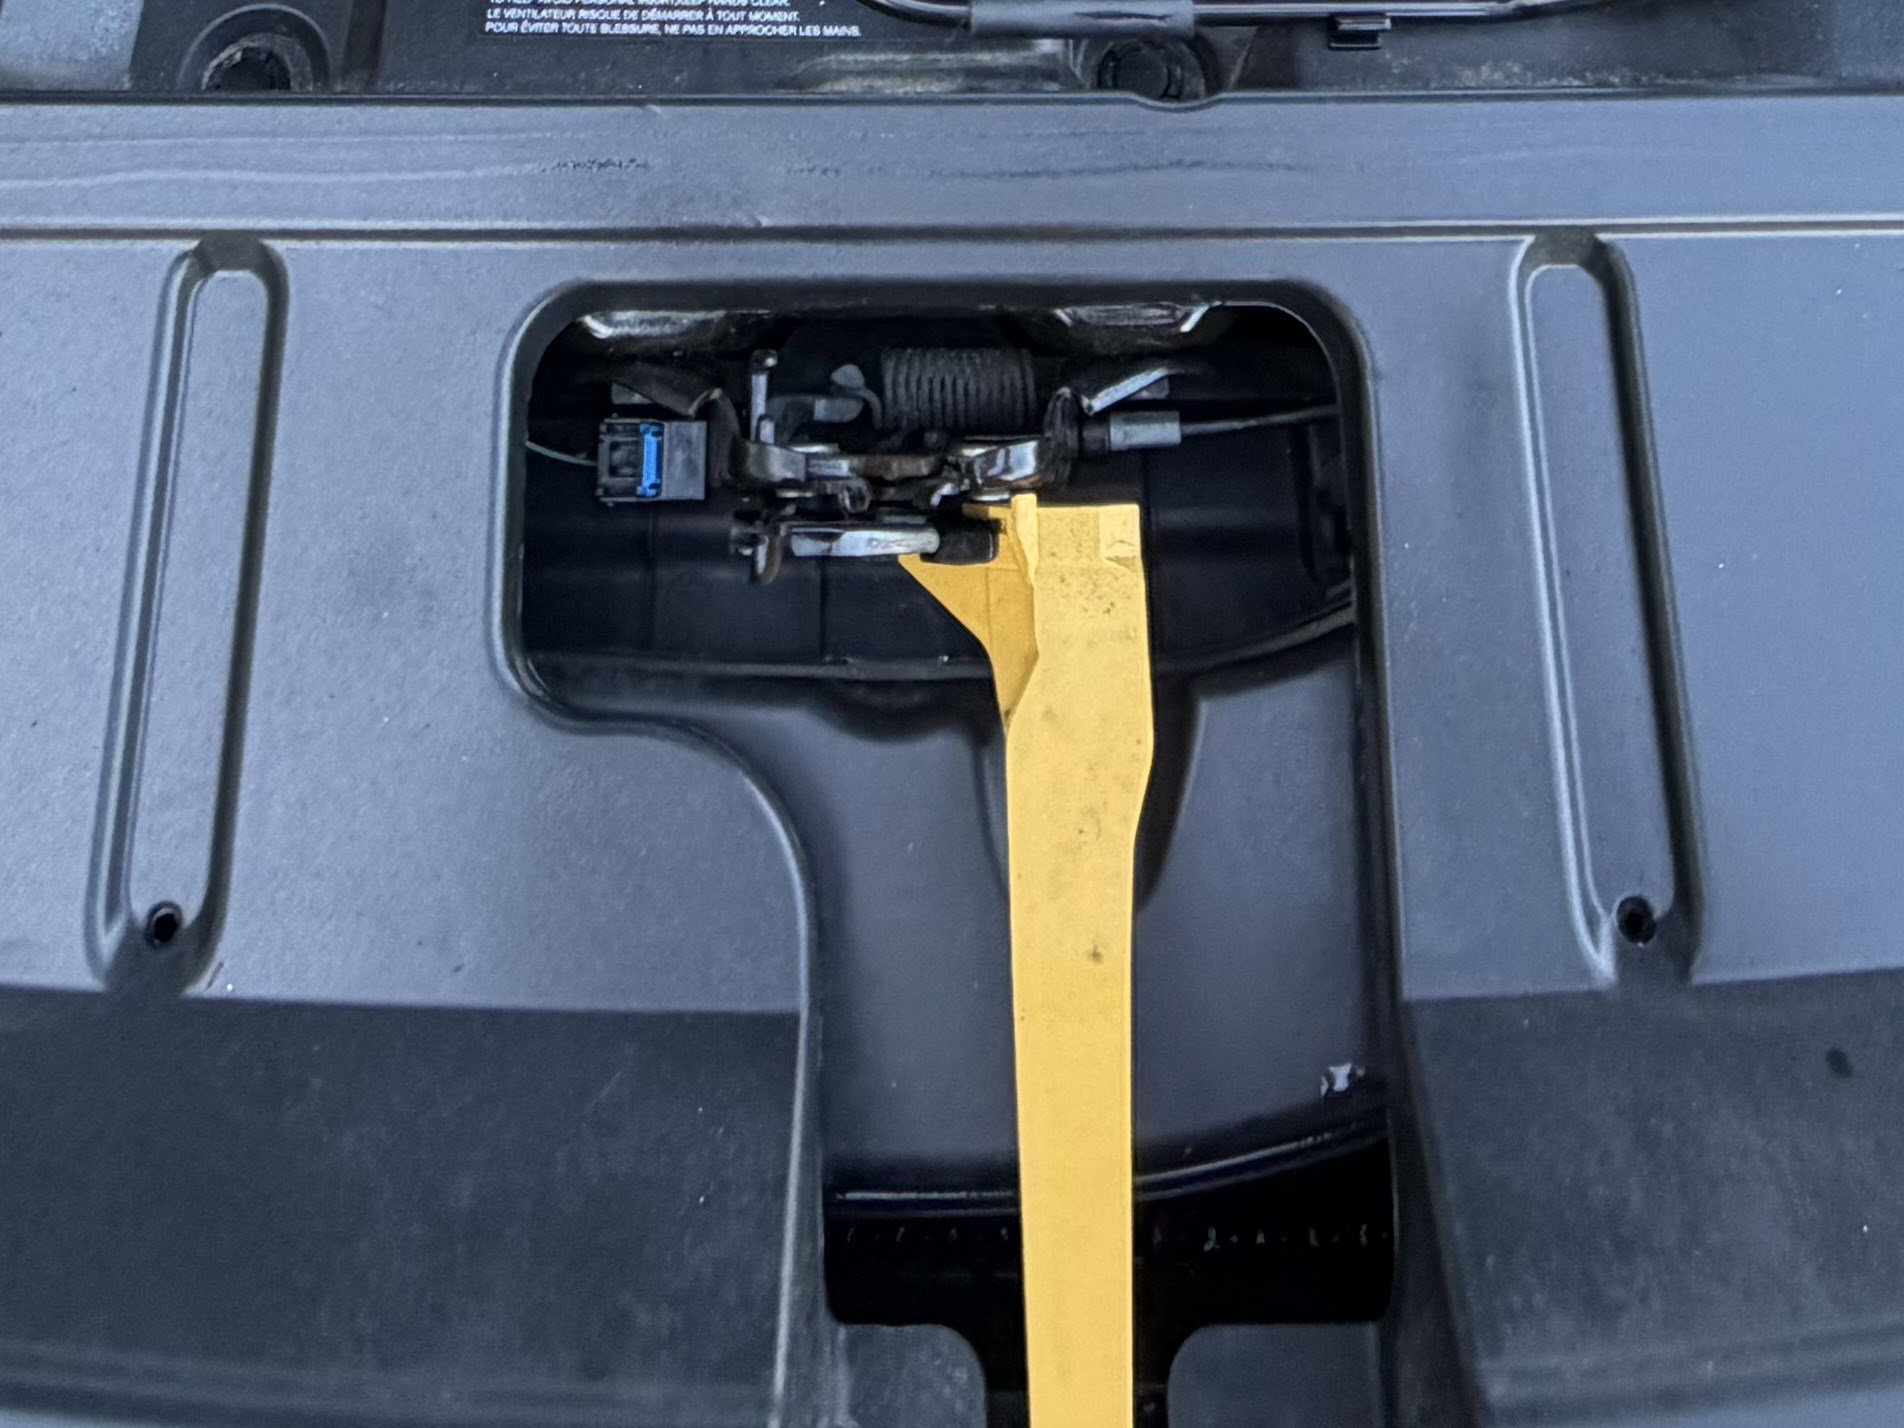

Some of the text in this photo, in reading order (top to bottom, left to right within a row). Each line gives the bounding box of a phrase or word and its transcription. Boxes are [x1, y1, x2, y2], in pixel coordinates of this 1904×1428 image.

[487, 8, 501, 19] LE
[503, 8, 576, 20] VENTILATEUR
[578, 9, 621, 20] RISQUE
[623, 10, 639, 20] DE
[716, 10, 746, 21] TOUT
[485, 21, 518, 33] POUR
[520, 19, 559, 34] ÉVITER
[561, 22, 598, 34] TOUTE
[664, 24, 680, 35] NE
[682, 24, 705, 35] PAS
[725, 24, 797, 36] APPROCHER
[799, 25, 821, 36] LES
